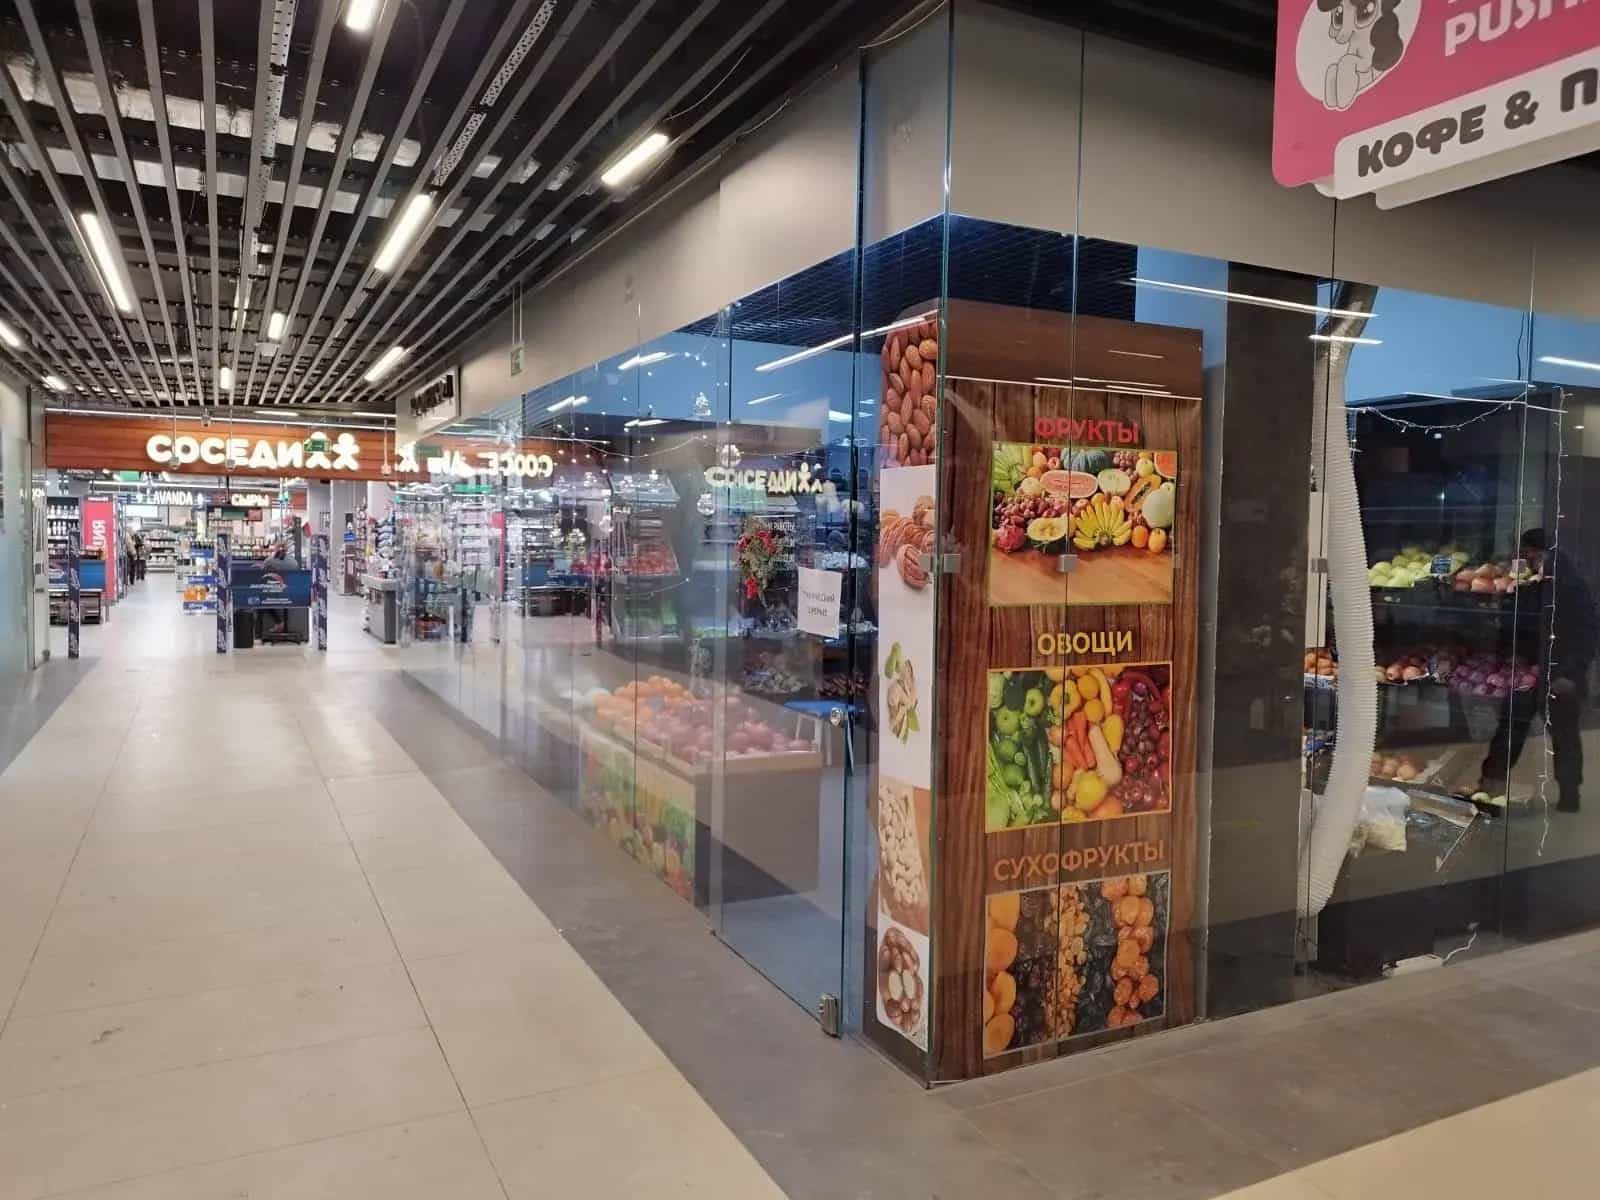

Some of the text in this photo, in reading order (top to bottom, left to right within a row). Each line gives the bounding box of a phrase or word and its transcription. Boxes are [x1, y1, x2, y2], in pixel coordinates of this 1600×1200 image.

[1357, 104, 1486, 178] КОФЕ
[1504, 90, 1540, 130] &
[1034, 416, 1140, 443] ФРУКТЫ
[146, 434, 303, 470] СОСЕДИ
[147, 489, 193, 506] LAVANDA
[1037, 631, 1133, 656] ОВОЩИ
[994, 839, 1165, 881] СУХОФРУКТЫ
